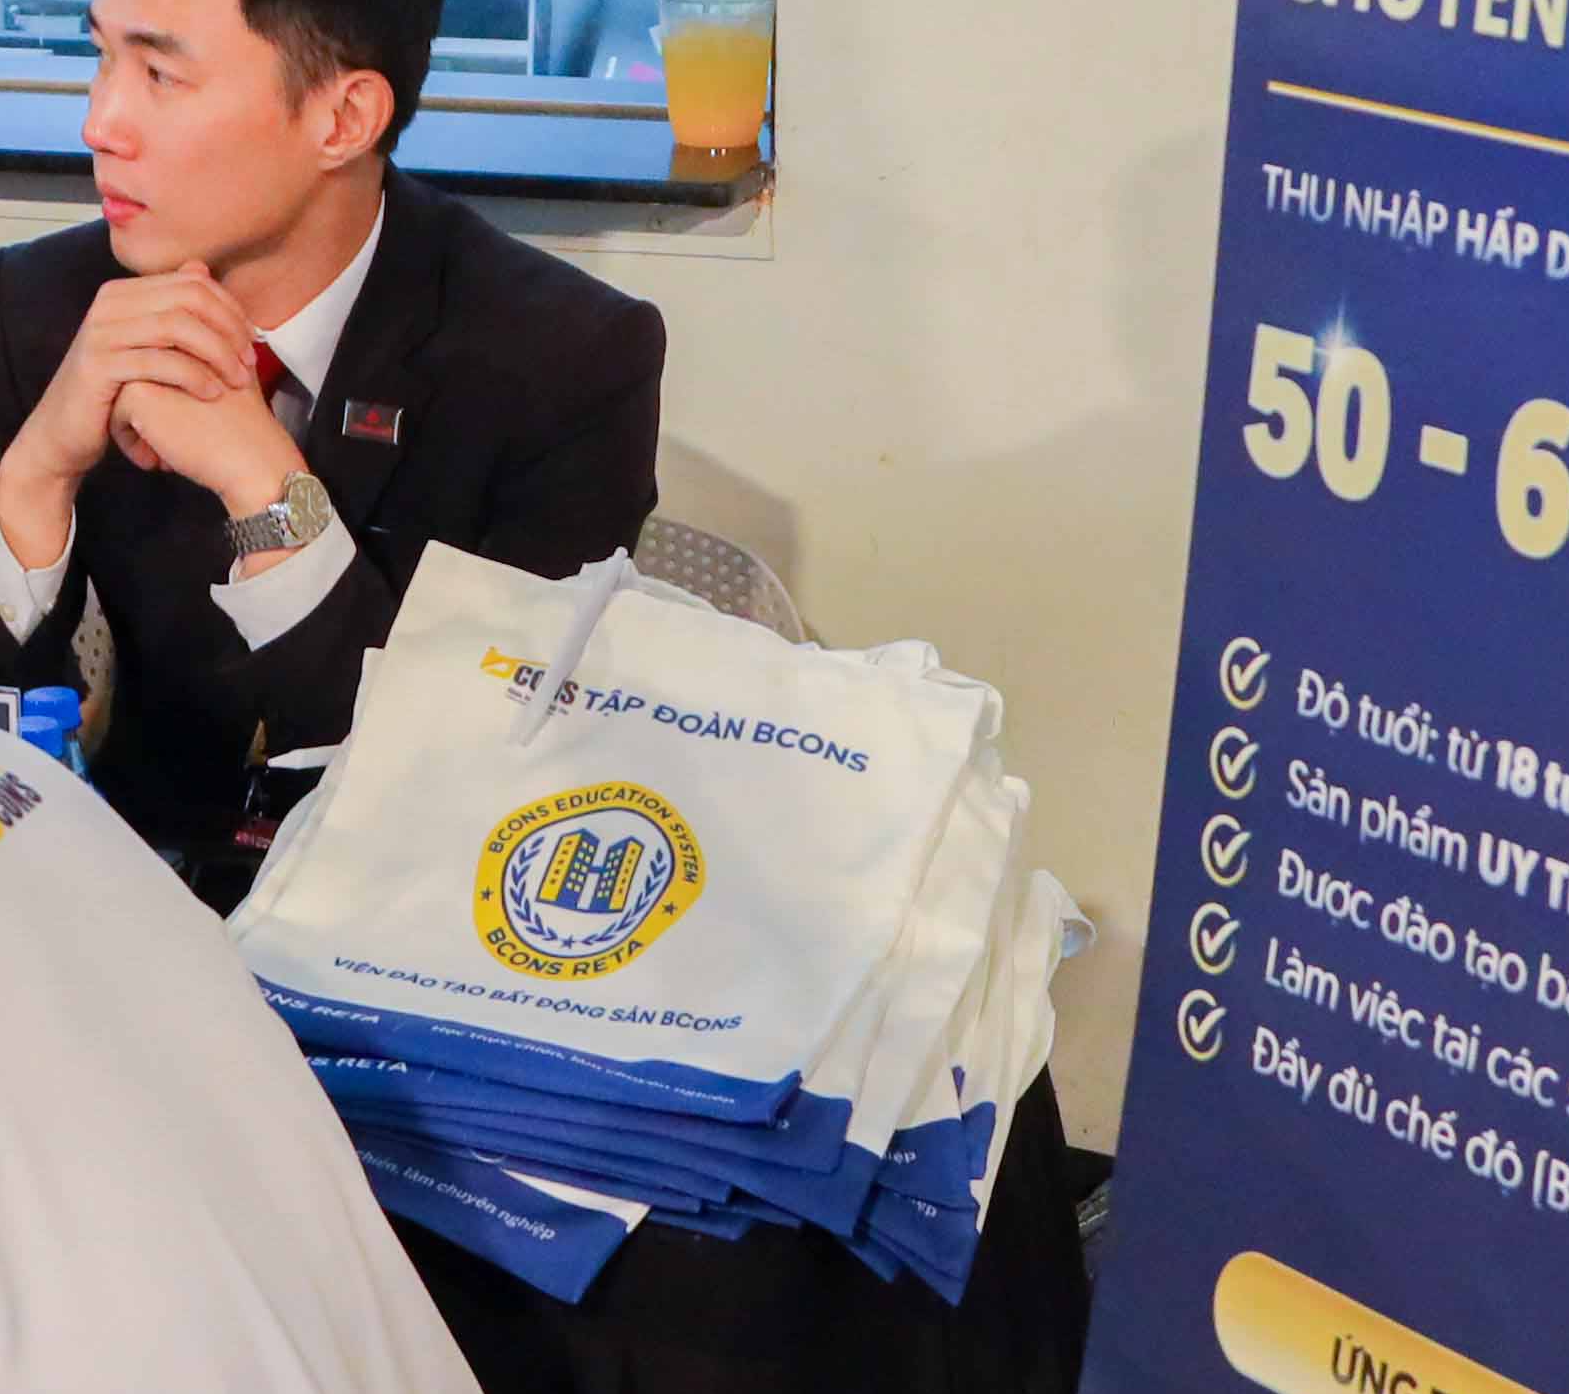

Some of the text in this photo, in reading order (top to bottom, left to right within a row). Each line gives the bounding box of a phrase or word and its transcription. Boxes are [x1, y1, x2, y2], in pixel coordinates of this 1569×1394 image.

[1263, 163, 1337, 222] THU
[1343, 183, 1448, 250] NHẬP
[1455, 206, 1539, 269] HẤP
[1241, 322, 1393, 502] 50
[1418, 425, 1470, 476] -
[584, 689, 870, 773] TẬP ĐOÀN BCONS
[1297, 668, 1350, 736] Độ
[1359, 694, 1438, 763] tuổi:
[1447, 726, 1489, 780] từ
[1495, 739, 1540, 799] 18
[488, 787, 699, 885] BCONS EDUCATION SYSTEM
[487, 926, 644, 975] BCONS RETA
